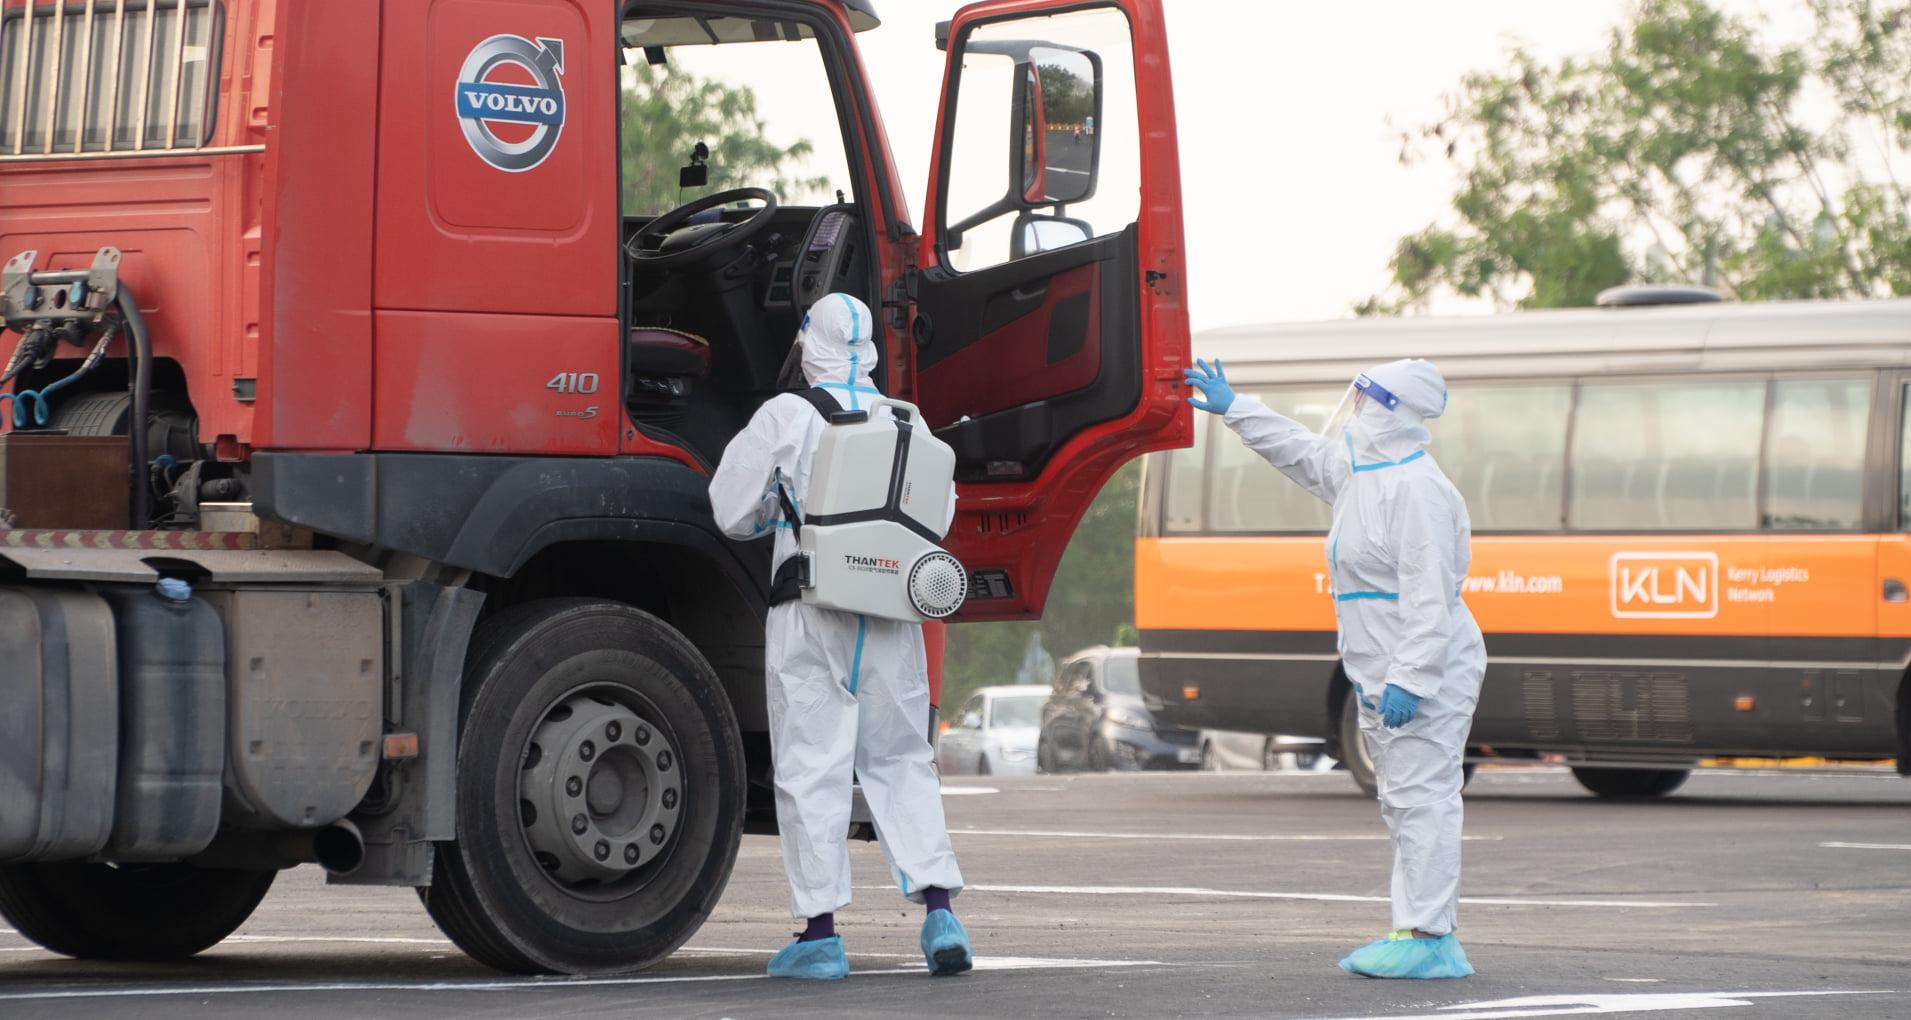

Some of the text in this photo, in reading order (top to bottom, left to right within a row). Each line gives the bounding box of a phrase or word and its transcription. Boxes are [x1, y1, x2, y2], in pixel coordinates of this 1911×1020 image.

[464, 91, 557, 115] VOLVO
[546, 372, 599, 394] 410
[845, 555, 900, 568] THANTEK
[1621, 567, 1707, 604] KLN
[1728, 567, 1809, 585] Kerry Logistics
[1728, 587, 1774, 602] Network
